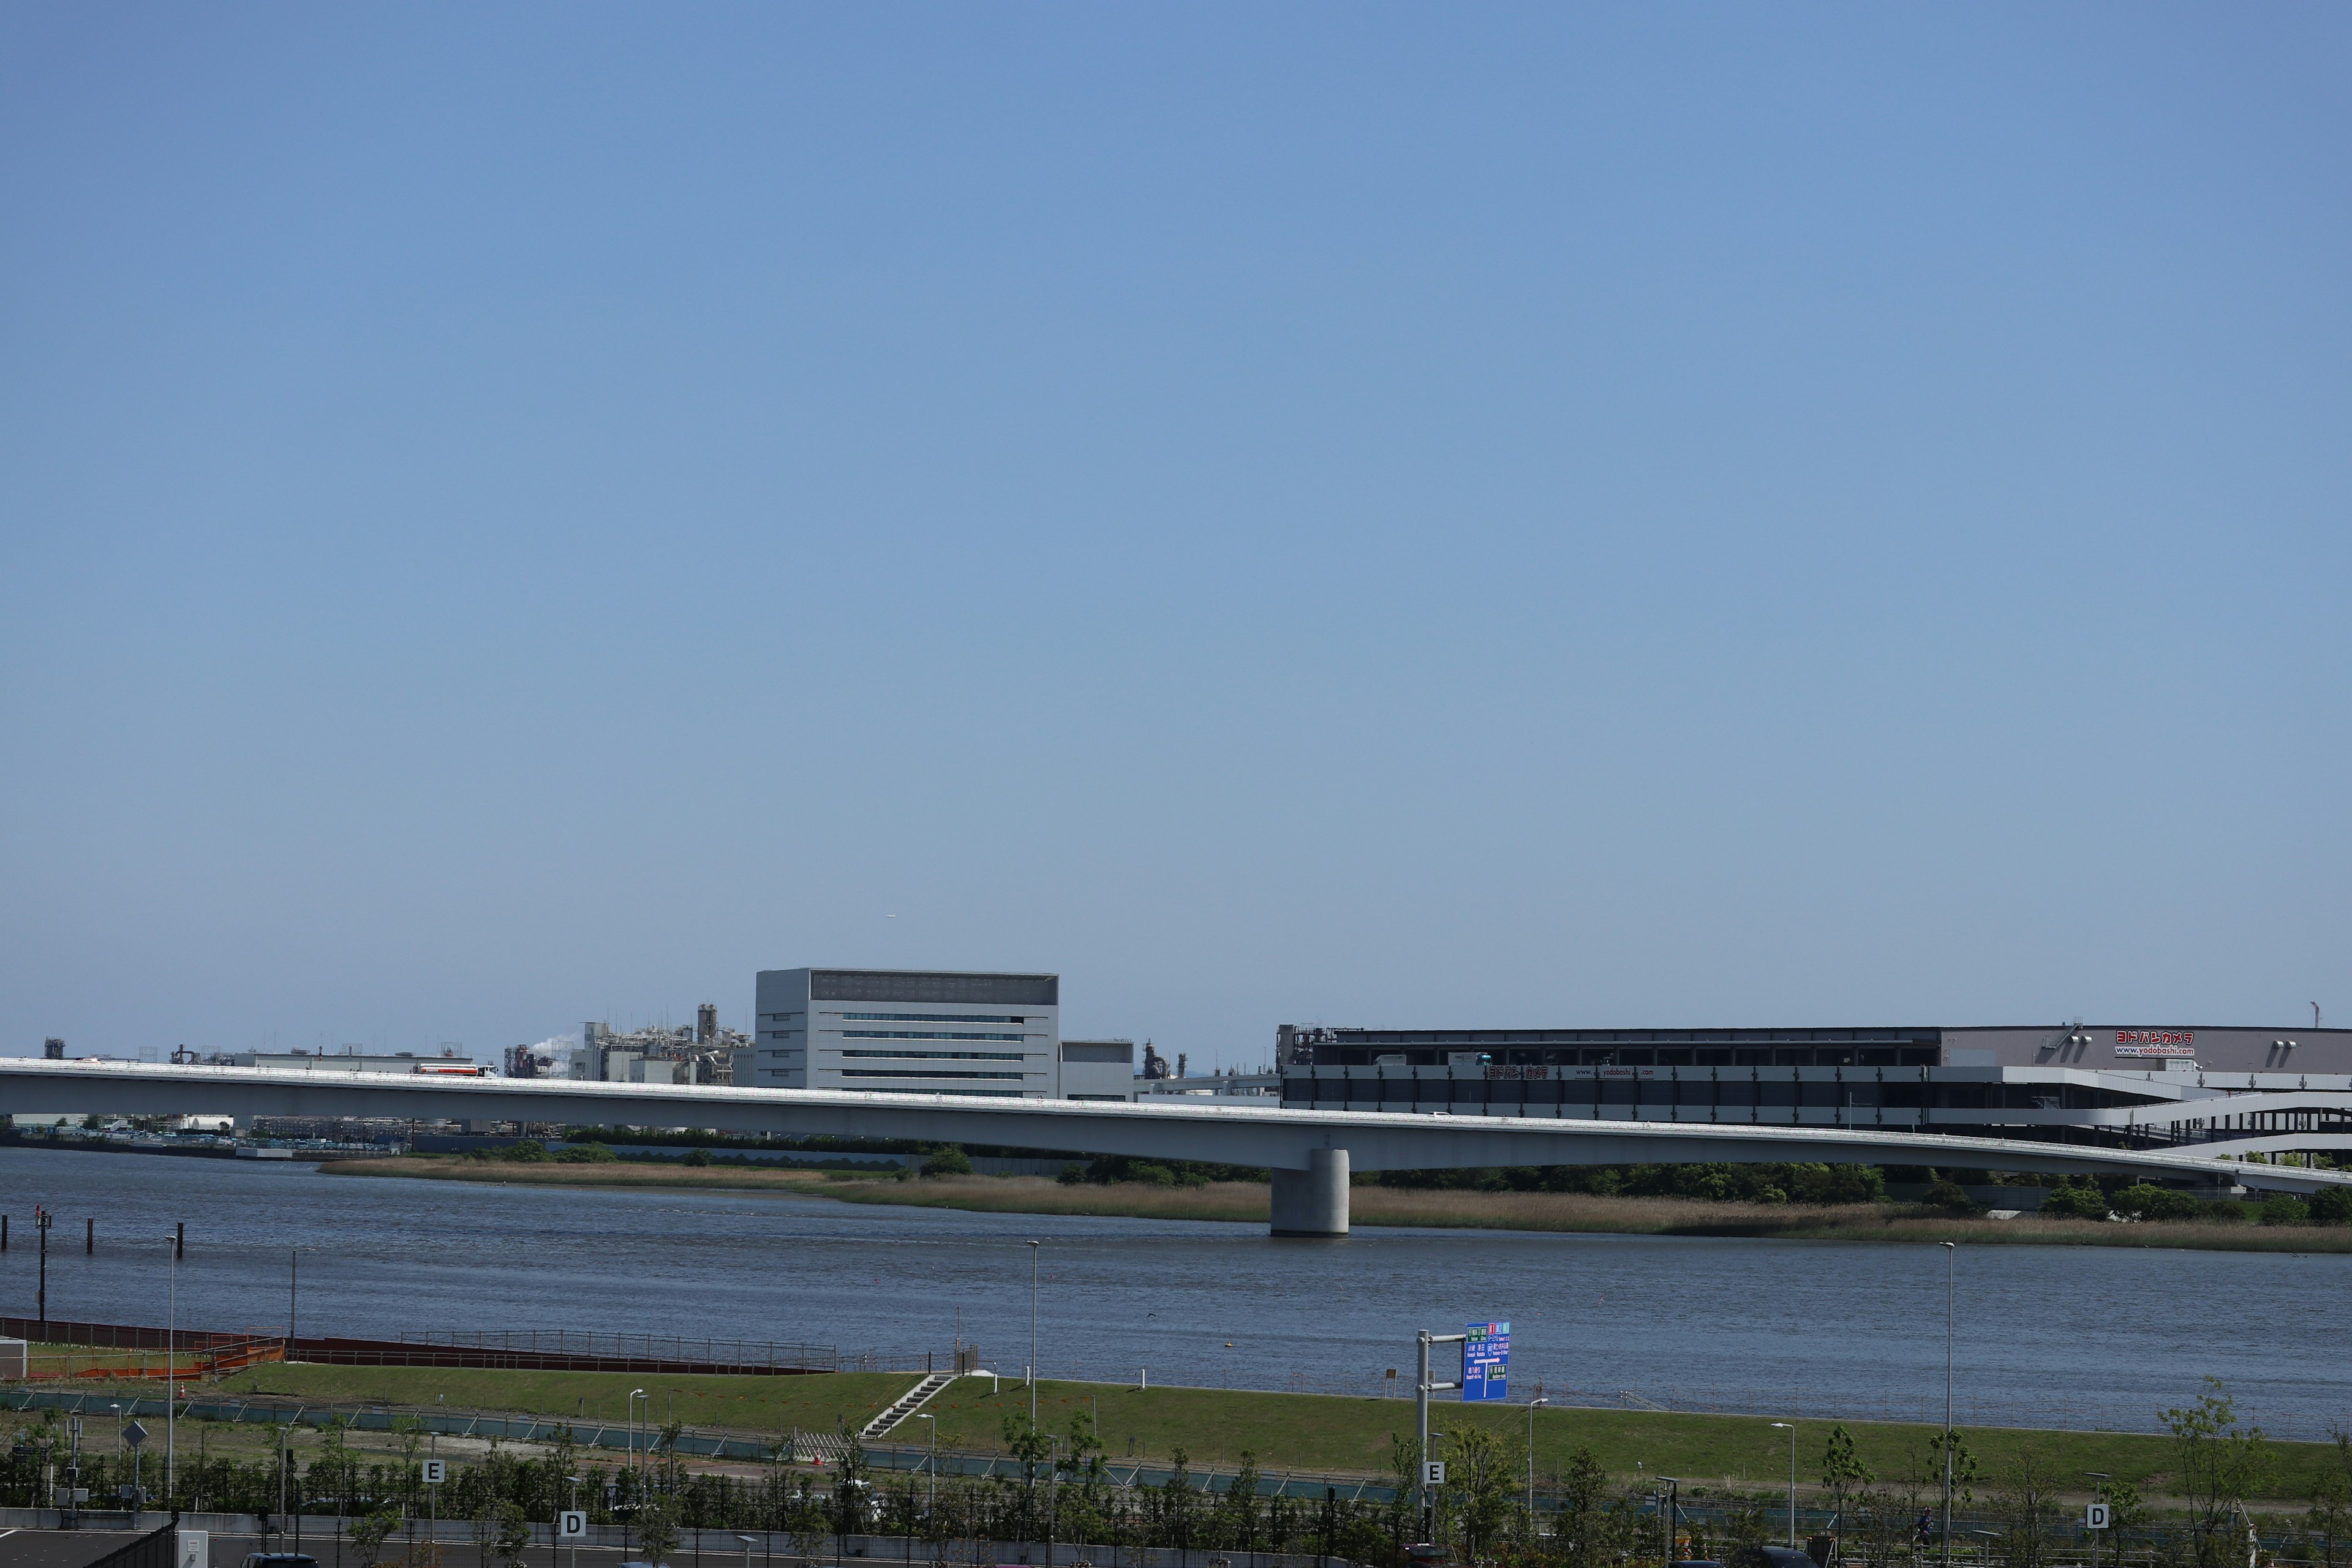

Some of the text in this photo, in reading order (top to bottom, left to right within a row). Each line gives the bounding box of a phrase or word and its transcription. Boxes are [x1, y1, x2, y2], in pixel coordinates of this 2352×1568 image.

[2116, 1030, 2194, 1045] ヨドバシカメラ
[2116, 1045, 2194, 1057] www.yodobashi.com
[429, 1463, 439, 1479] E
[1430, 1465, 1439, 1480] E
[567, 1515, 580, 1533] D
[2092, 1508, 2104, 1525] D
